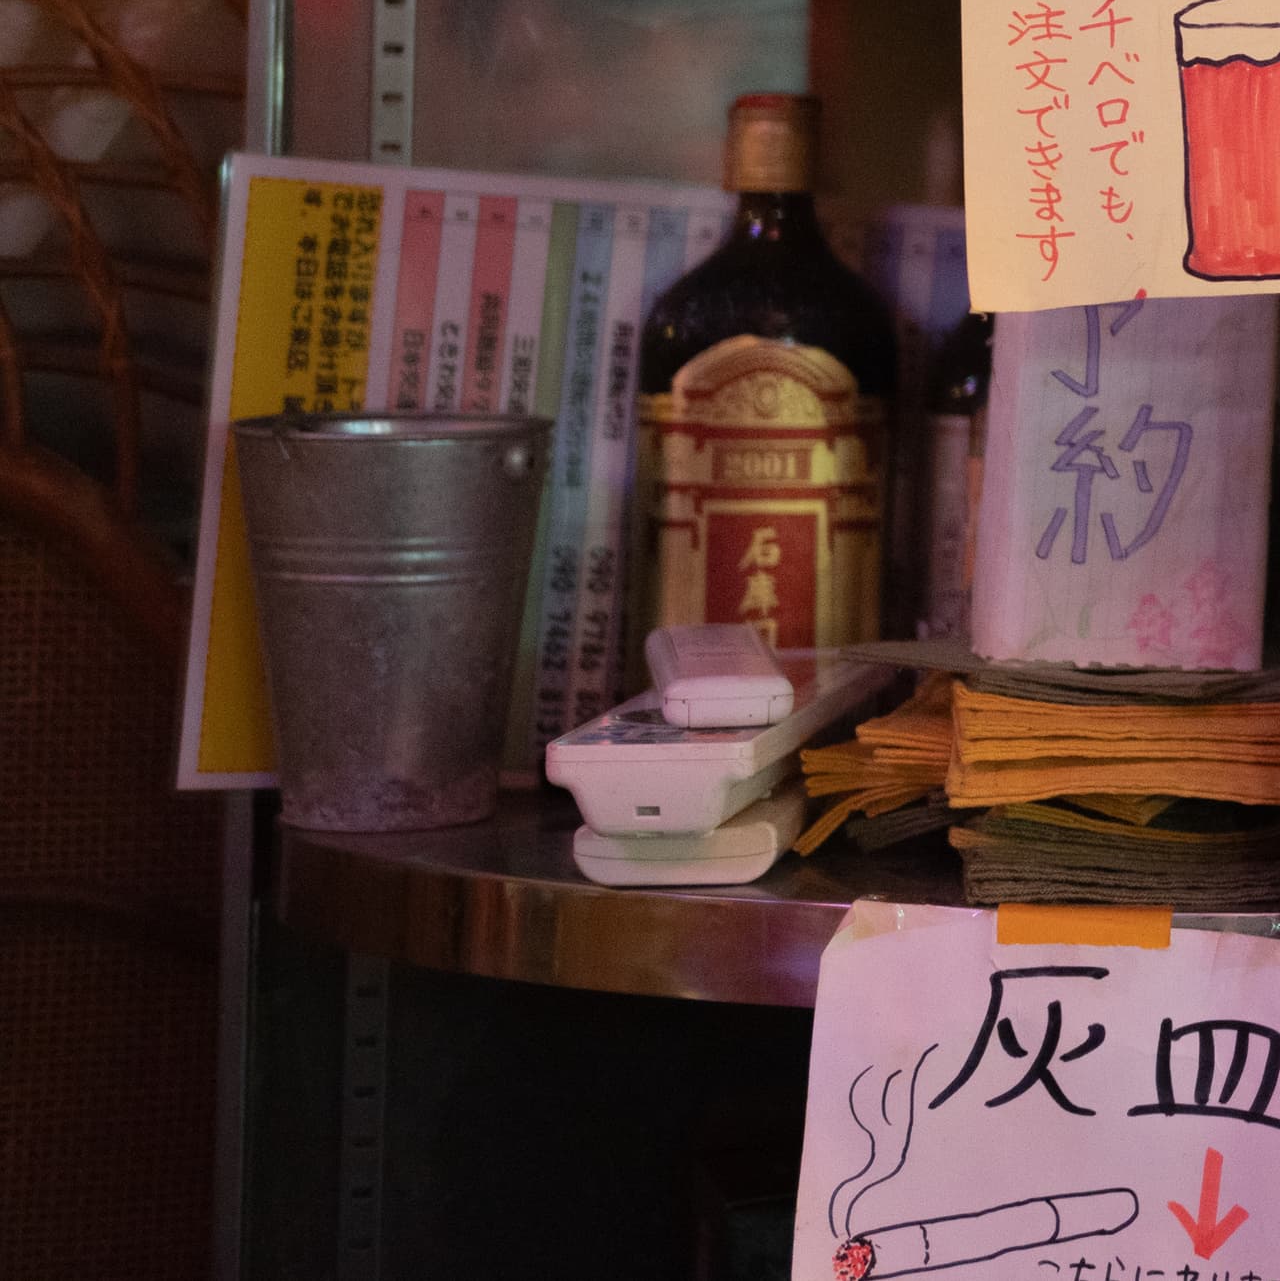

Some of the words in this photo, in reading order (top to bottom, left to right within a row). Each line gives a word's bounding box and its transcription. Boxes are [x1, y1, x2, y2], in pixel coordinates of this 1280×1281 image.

[1007, 2, 1076, 282] 注文できます
[724, 450, 798, 480] 2001
